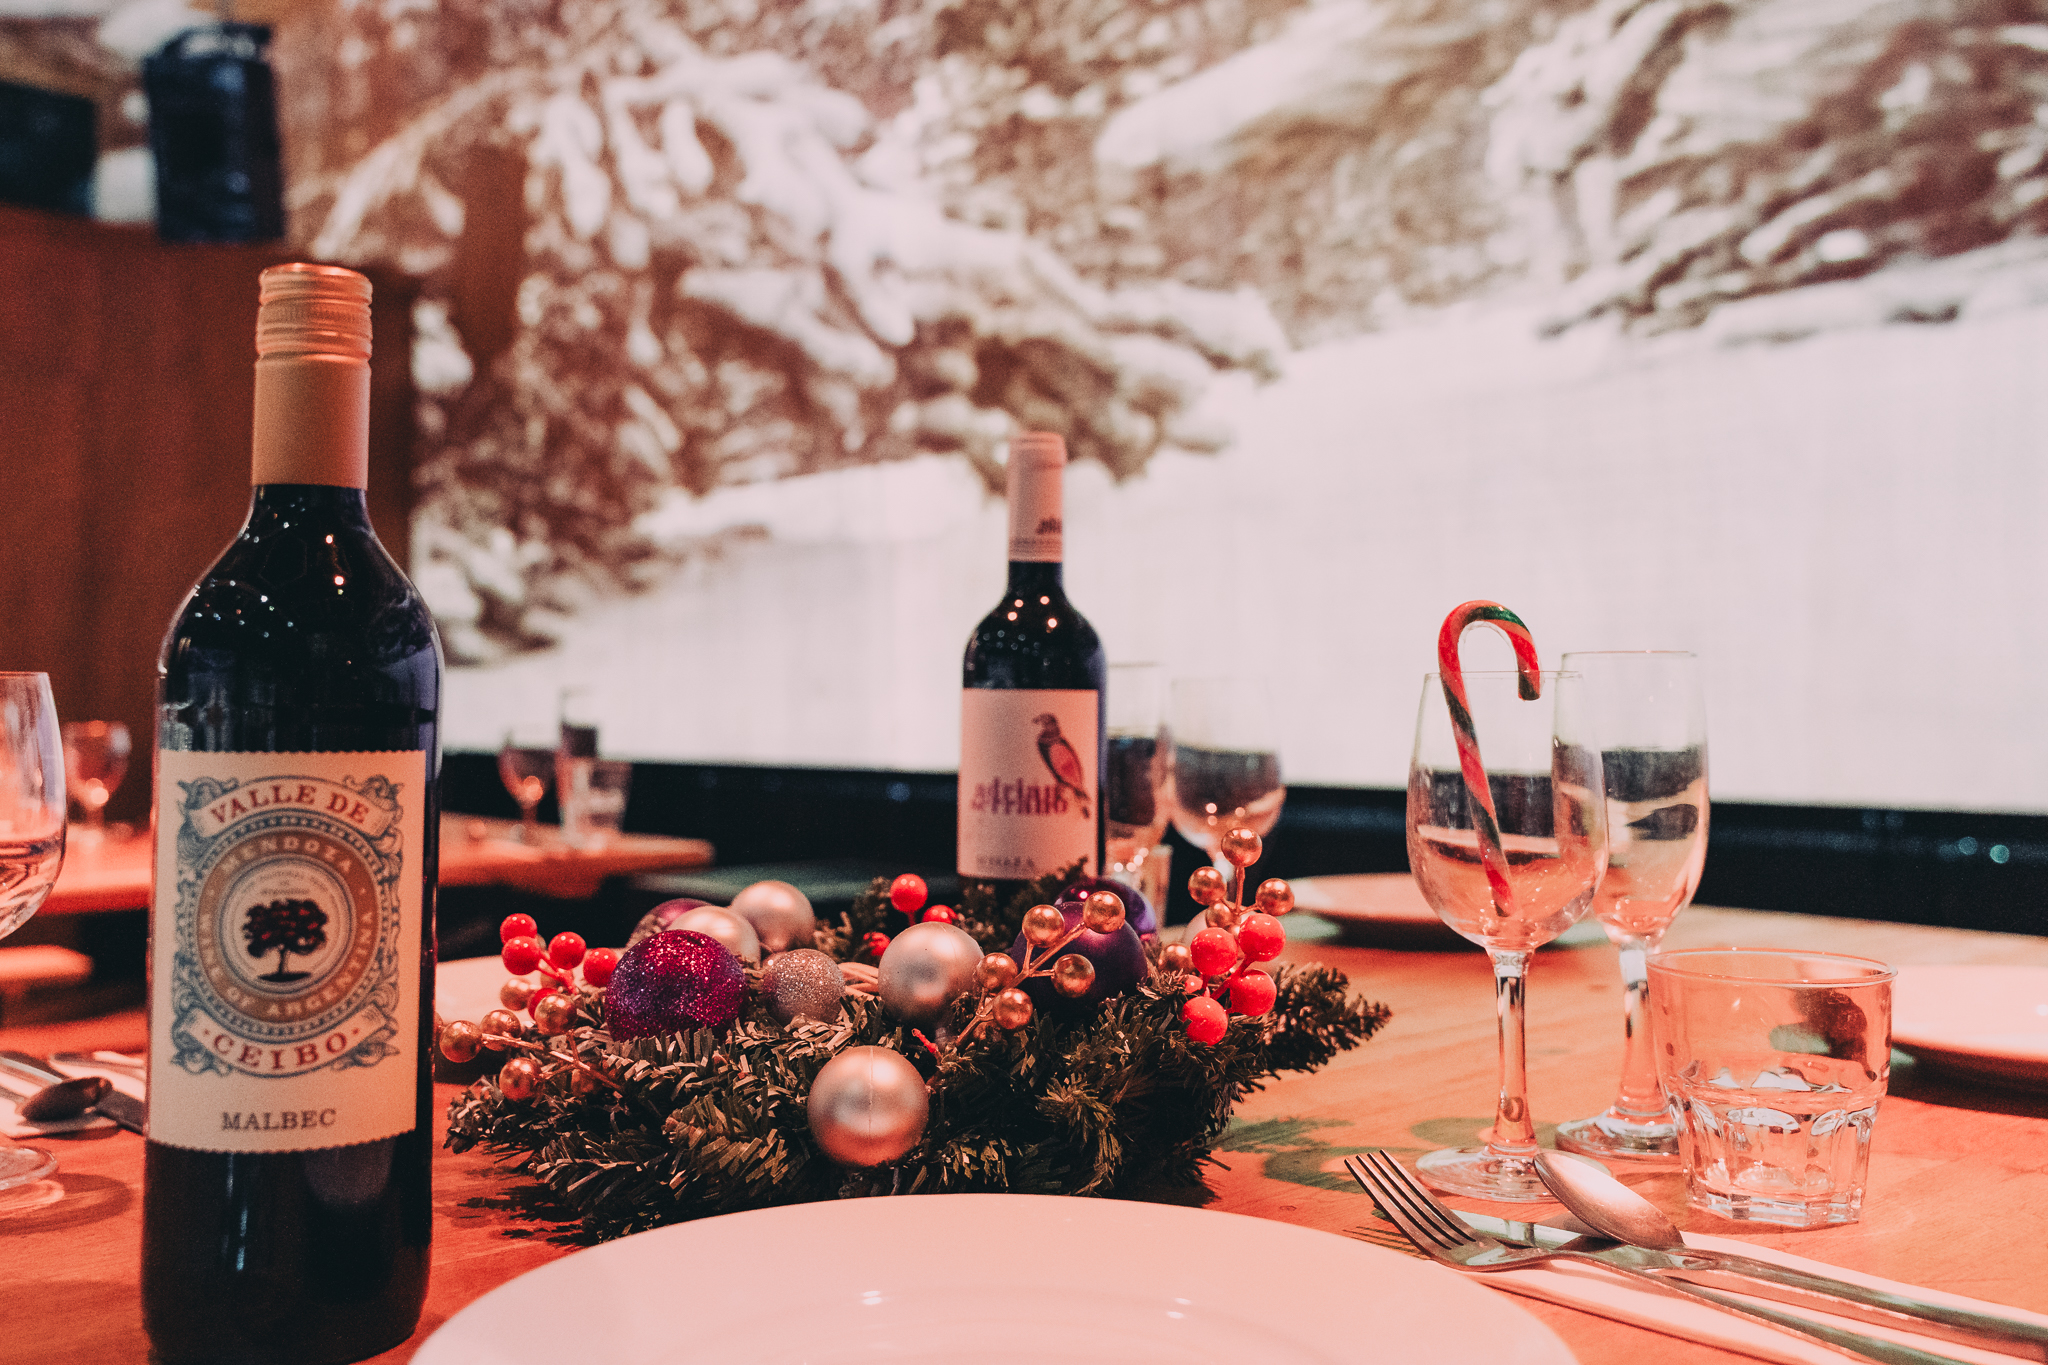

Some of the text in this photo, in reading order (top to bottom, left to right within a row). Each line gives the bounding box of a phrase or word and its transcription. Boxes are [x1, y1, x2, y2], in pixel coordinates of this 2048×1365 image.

[210, 784, 370, 824] VALLE DE
[221, 835, 352, 873] MENDOZA
[213, 1032, 348, 1070] CEIBO
[221, 1108, 337, 1131] MALBEC
